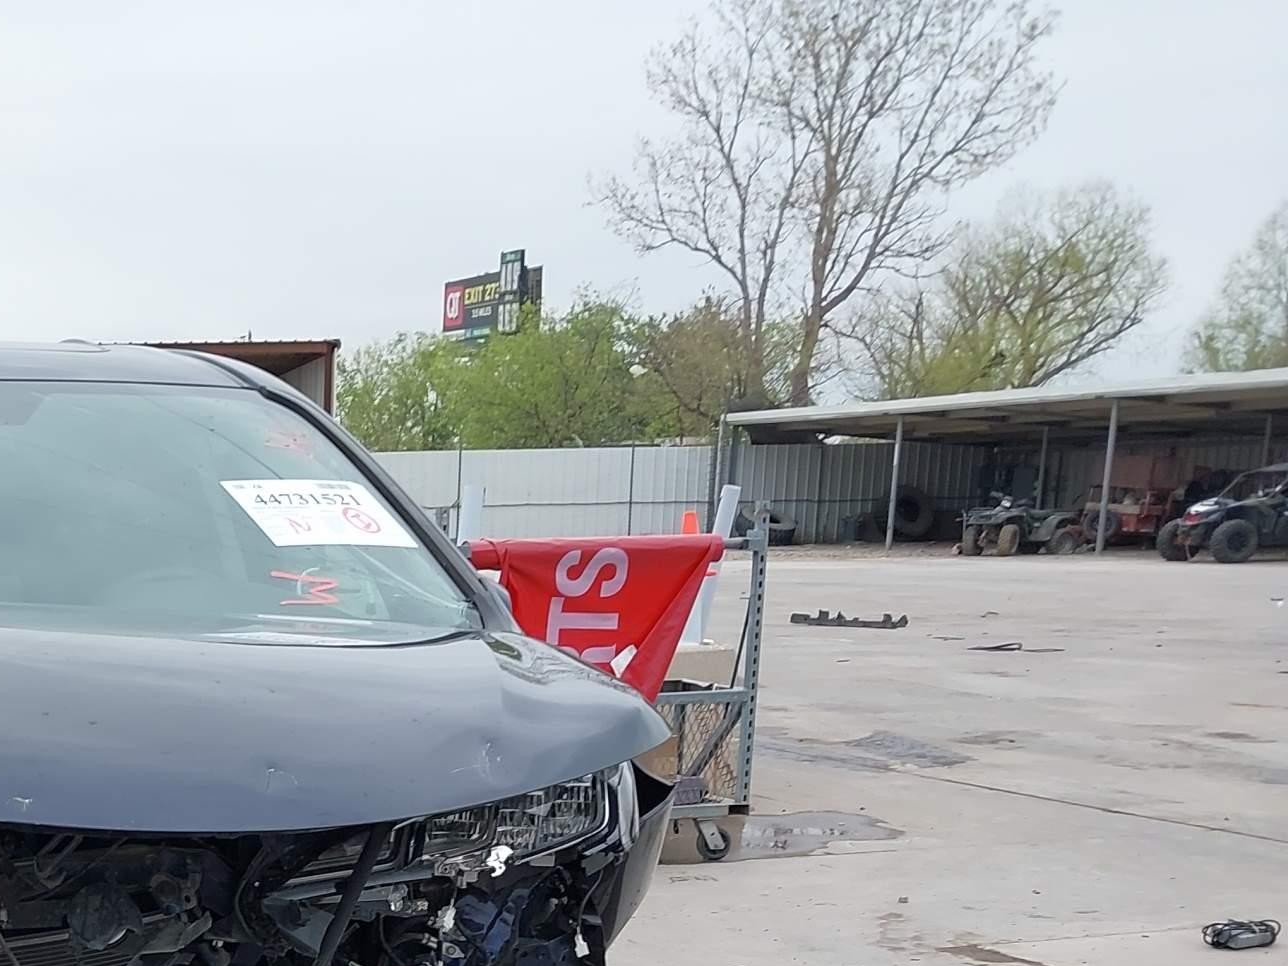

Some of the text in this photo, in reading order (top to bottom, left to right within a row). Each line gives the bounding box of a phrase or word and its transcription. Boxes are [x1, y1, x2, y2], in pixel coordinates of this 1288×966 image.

[447, 291, 461, 319] QT
[464, 286, 483, 305] EXIT
[253, 493, 362, 506] 44731521
